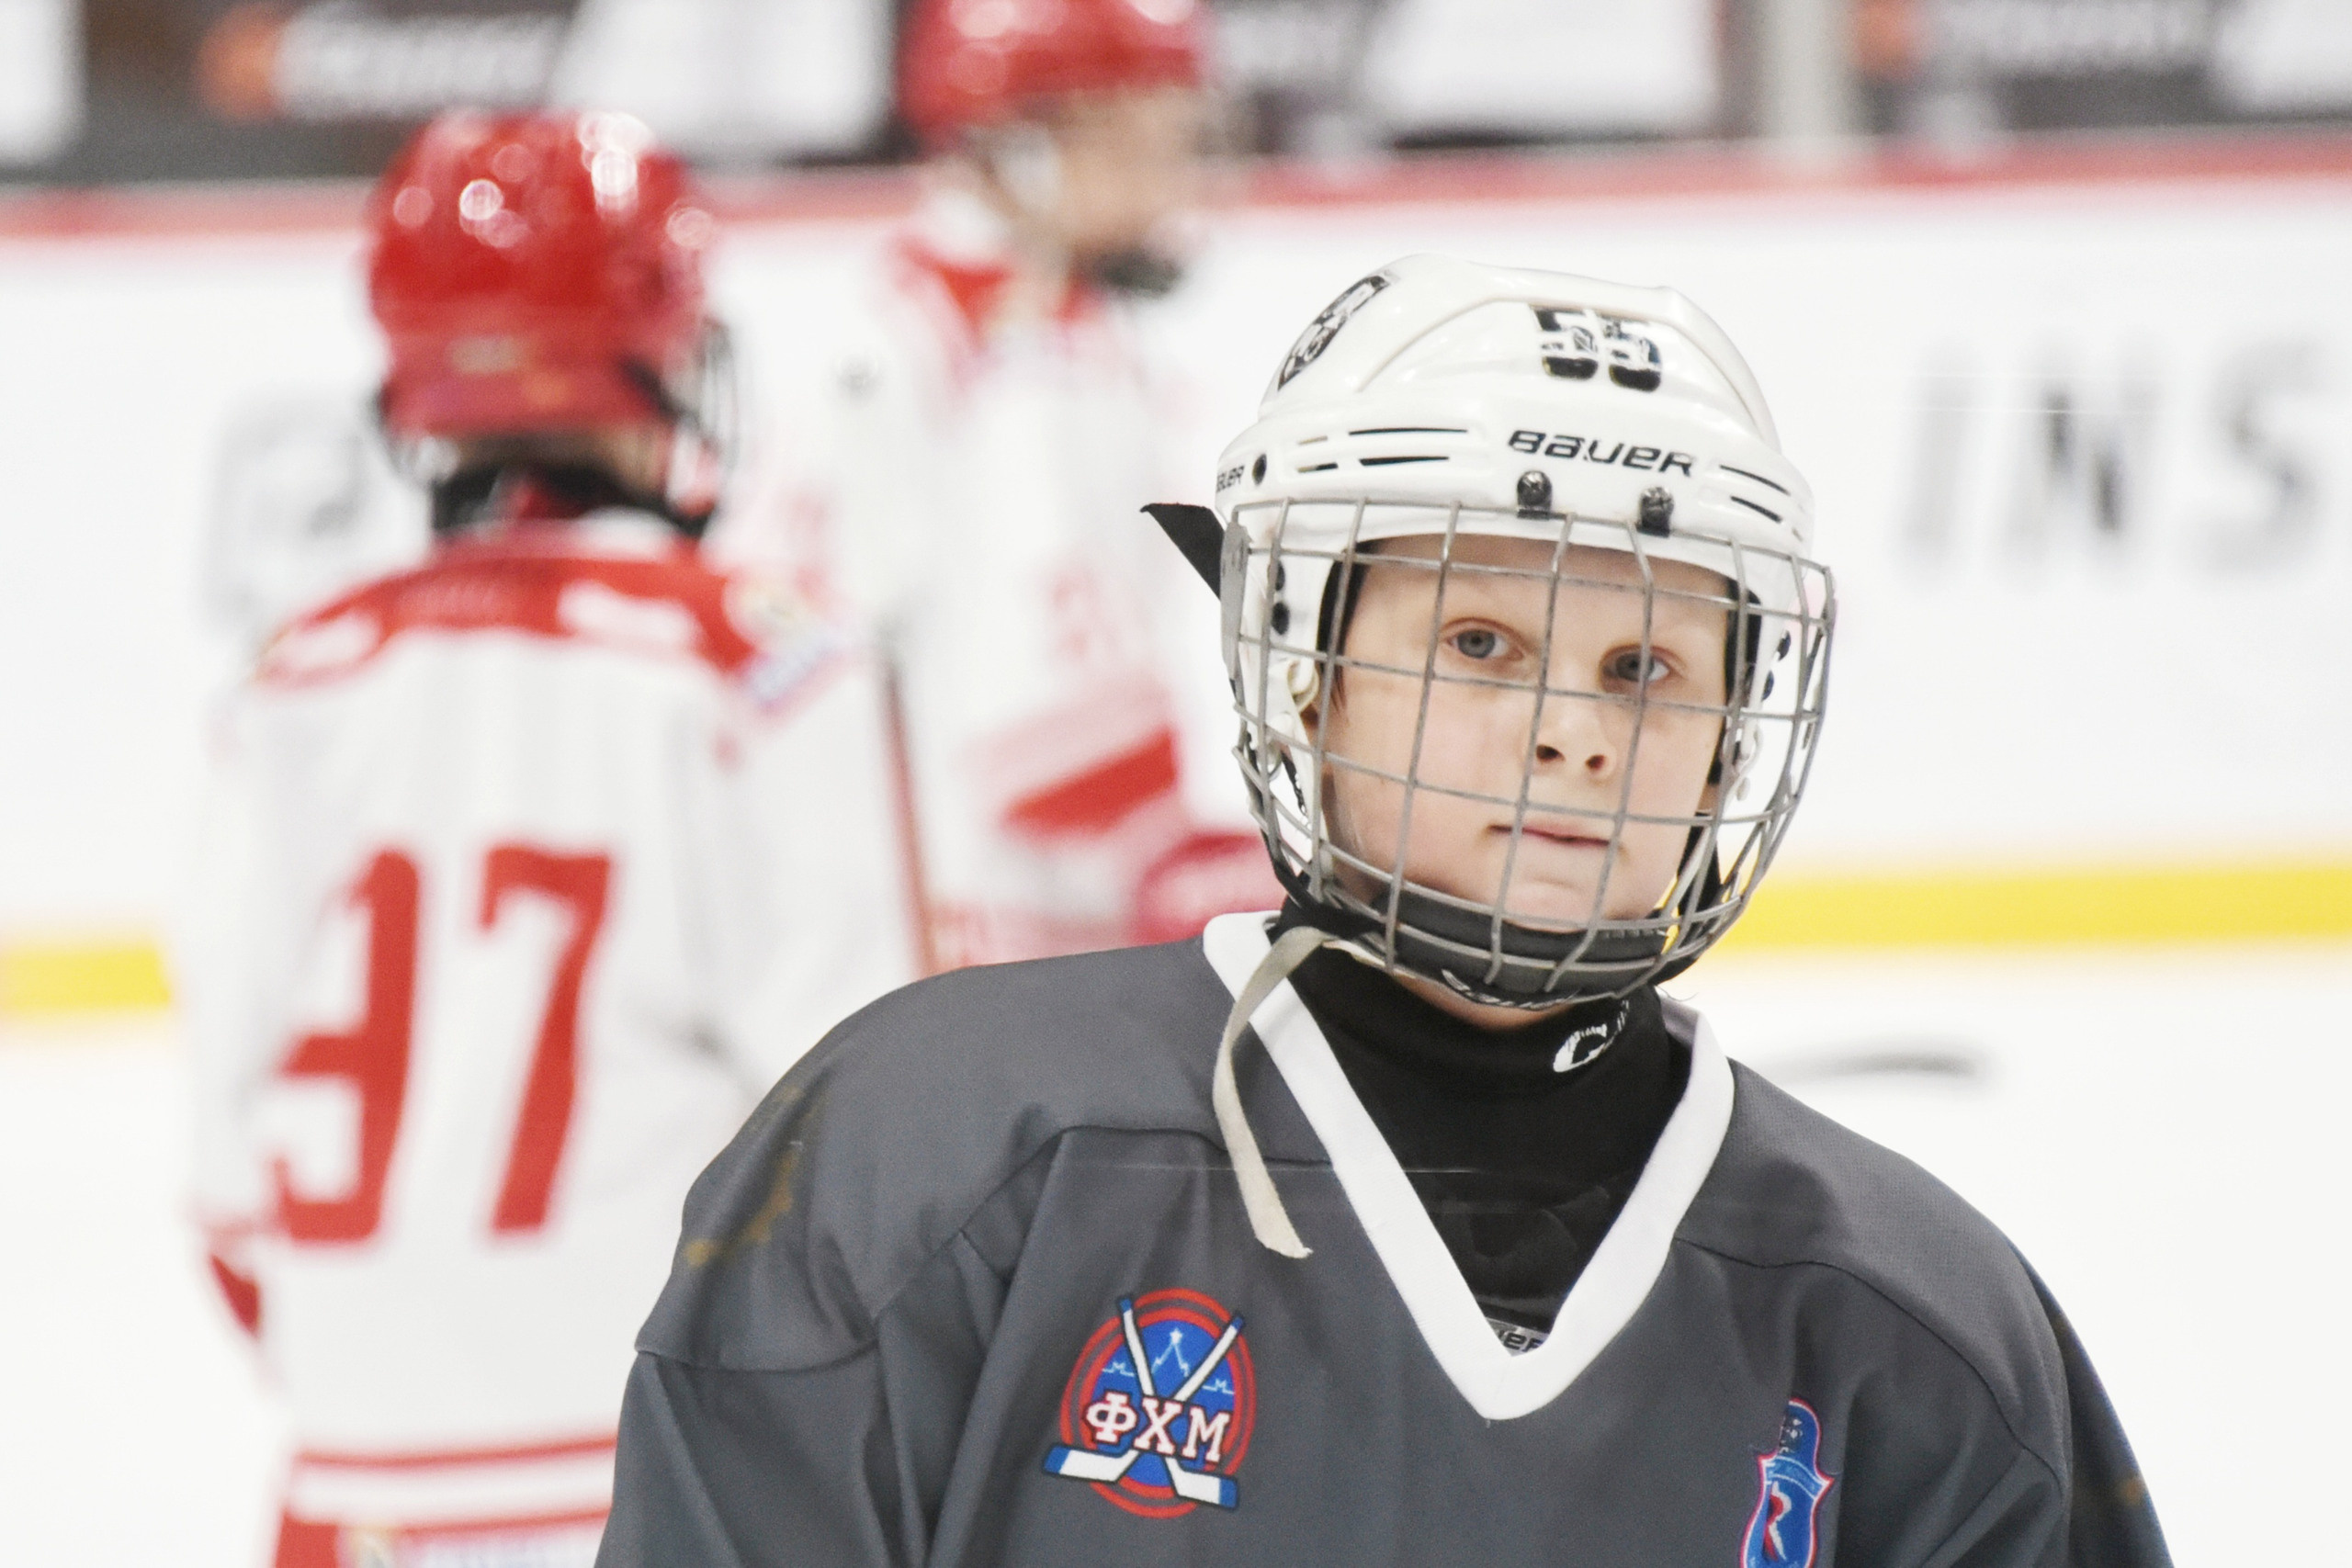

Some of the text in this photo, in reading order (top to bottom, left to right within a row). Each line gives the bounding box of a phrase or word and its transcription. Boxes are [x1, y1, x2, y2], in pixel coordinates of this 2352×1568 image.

[1508, 429, 1694, 478] BAUER
[273, 843, 614, 1243] 37
[1084, 1390, 1232, 1464] ФХМ
